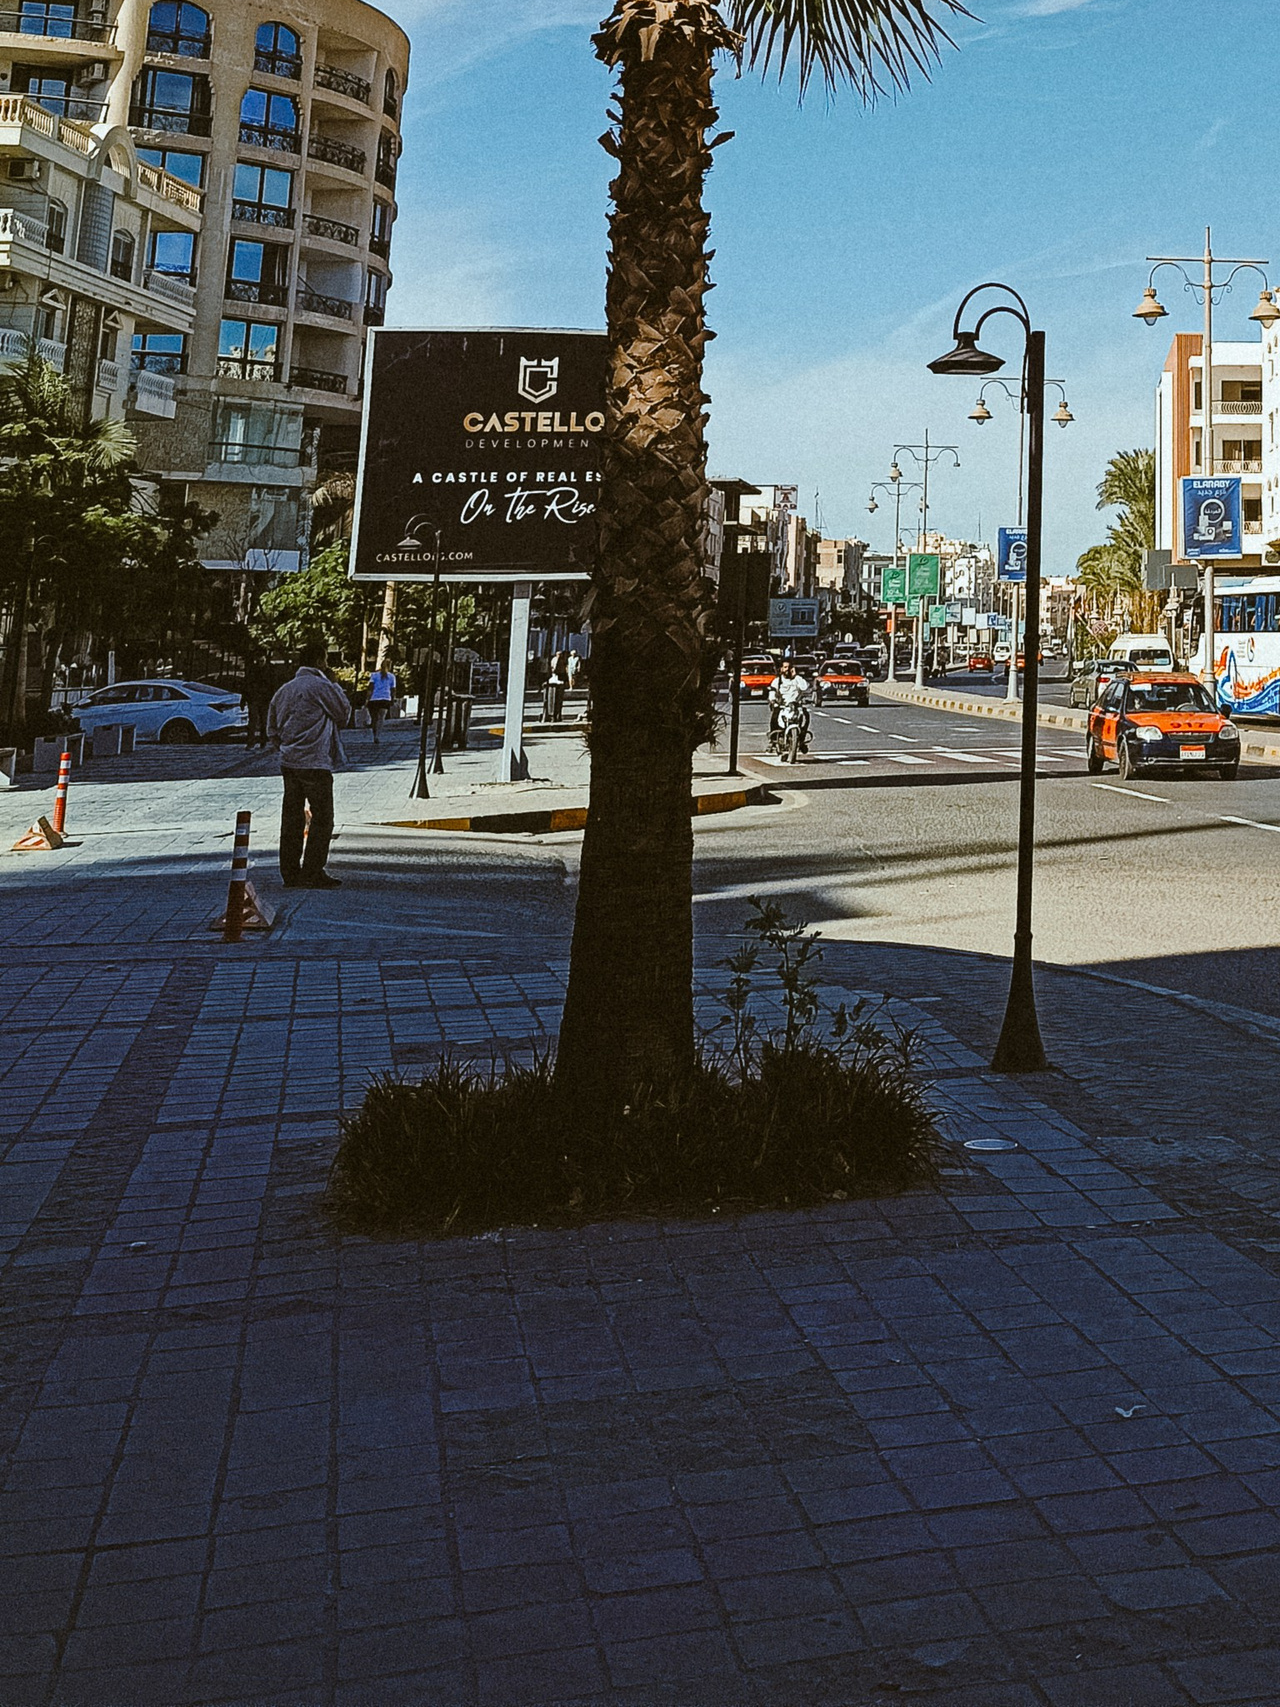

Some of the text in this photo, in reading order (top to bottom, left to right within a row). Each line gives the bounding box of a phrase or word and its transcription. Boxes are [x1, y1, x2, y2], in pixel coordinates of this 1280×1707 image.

[463, 411, 606, 433] CASTELLO
[465, 438, 590, 449] DEVELOPMEN
[412, 472, 424, 484] A
[431, 472, 498, 484] CASTLE
[506, 471, 528, 483] OF
[536, 471, 578, 482] REAL
[1193, 480, 1231, 489] ELARABY
[460, 488, 497, 524] On
